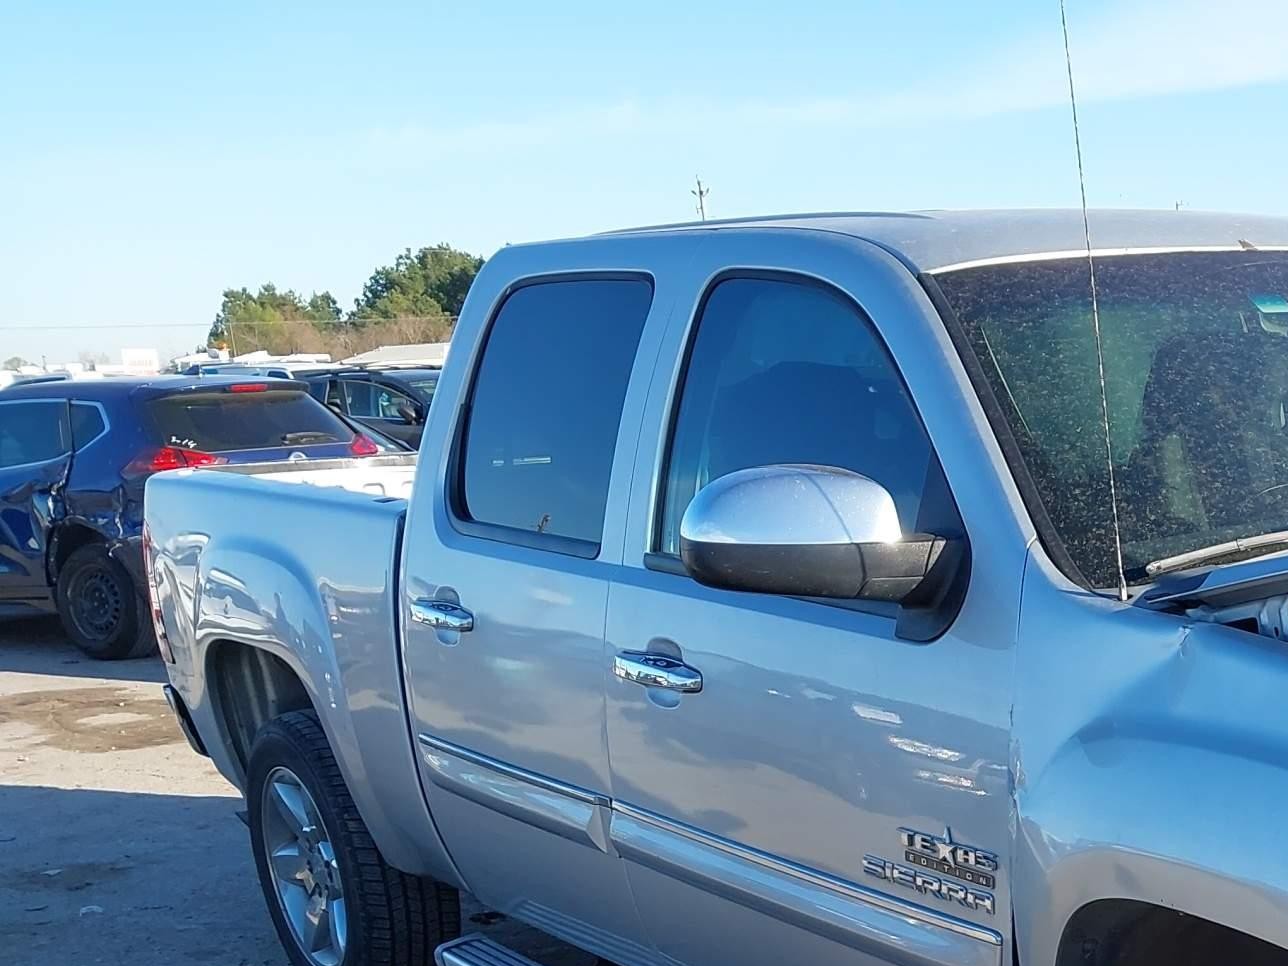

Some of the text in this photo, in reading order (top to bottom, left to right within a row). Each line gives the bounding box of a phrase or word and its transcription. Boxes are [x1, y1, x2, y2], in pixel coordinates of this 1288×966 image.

[896, 824, 999, 872] TEXAS
[908, 854, 988, 887] EDITION
[861, 854, 996, 915] SIERRA
